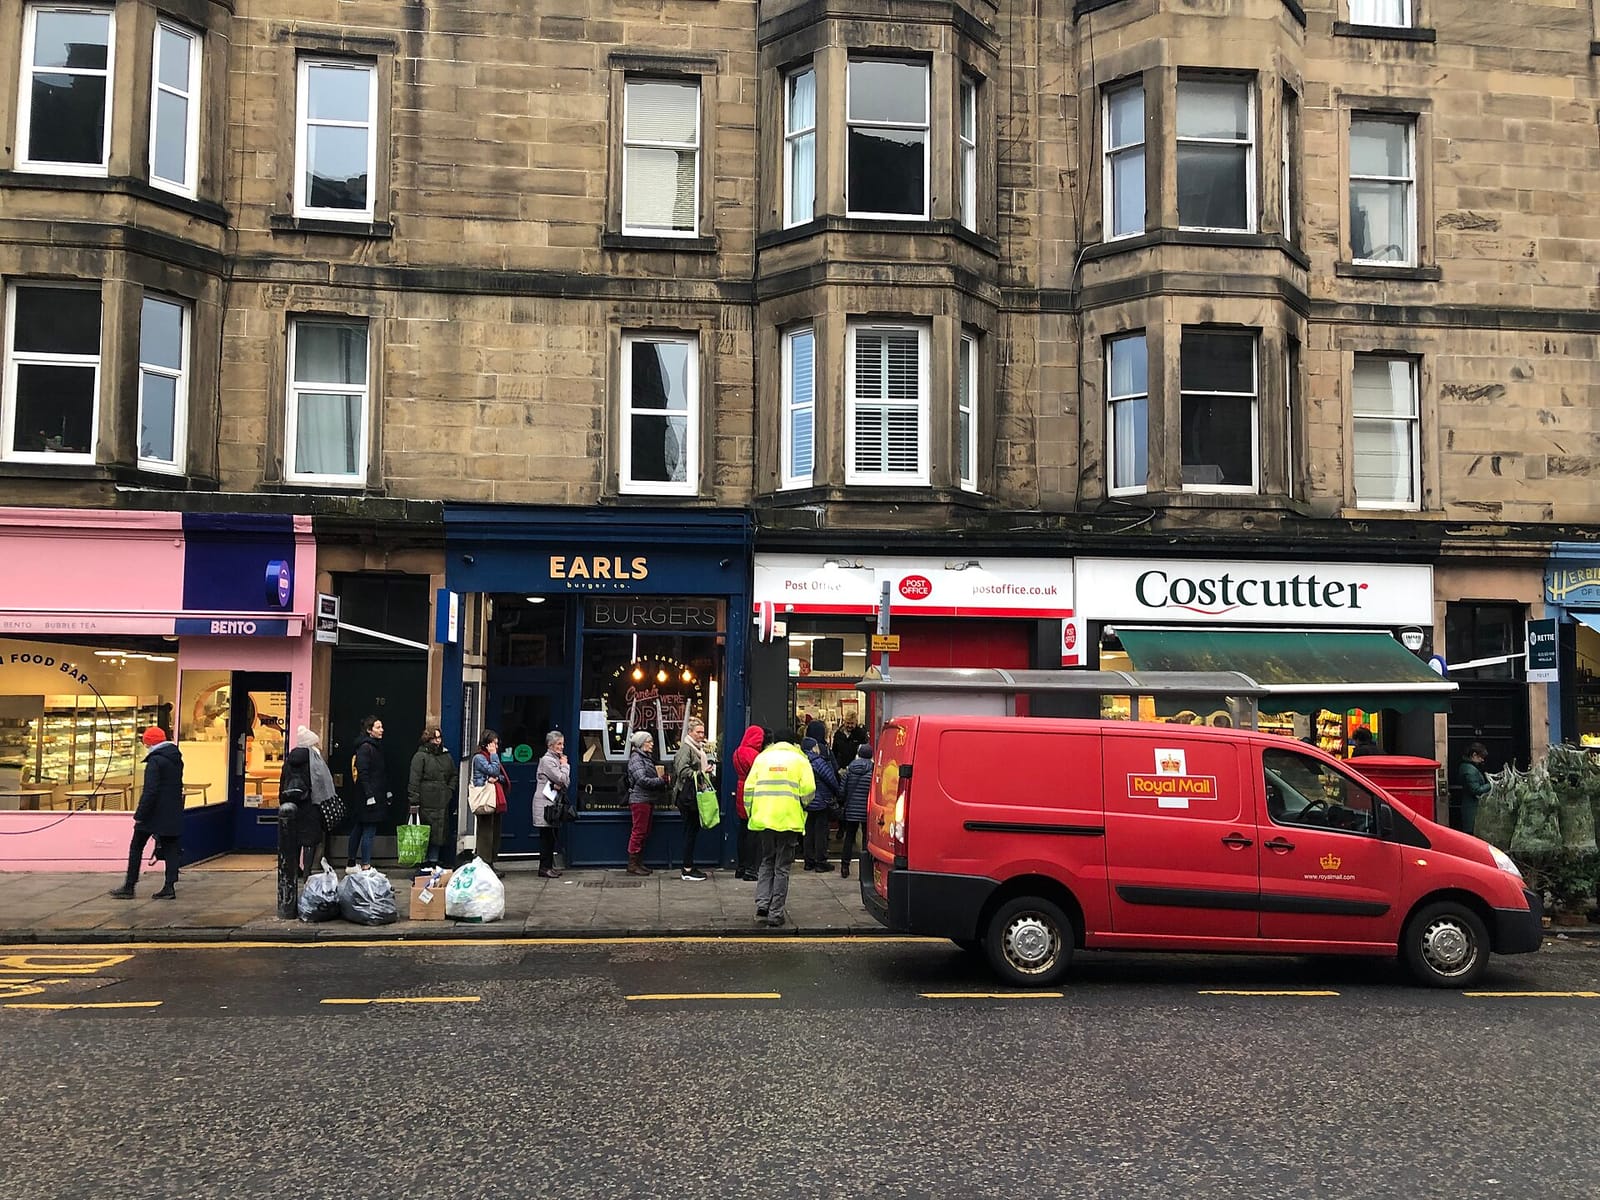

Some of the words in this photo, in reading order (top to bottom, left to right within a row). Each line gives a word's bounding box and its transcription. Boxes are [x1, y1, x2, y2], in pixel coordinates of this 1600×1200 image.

[550, 556, 649, 580] EARLS
[566, 582, 607, 590] burger
[785, 580, 808, 591] Post
[811, 581, 842, 591] Office
[901, 586, 929, 595] OFFICE
[972, 583, 1058, 597] postoffice.co.uk
[1135, 570, 1369, 608] Costcutter
[594, 604, 716, 626] BURGERS
[3, 621, 32, 629] BENTO
[44, 622, 77, 630] BUBBLE
[80, 622, 97, 630] TEA
[210, 620, 257, 635] BENTO
[10, 653, 55, 667] FOOD
[60, 662, 88, 684] BAR
[626, 705, 686, 730] OPEN
[1134, 777, 1176, 795] Royal
[1179, 779, 1210, 793] Mail
